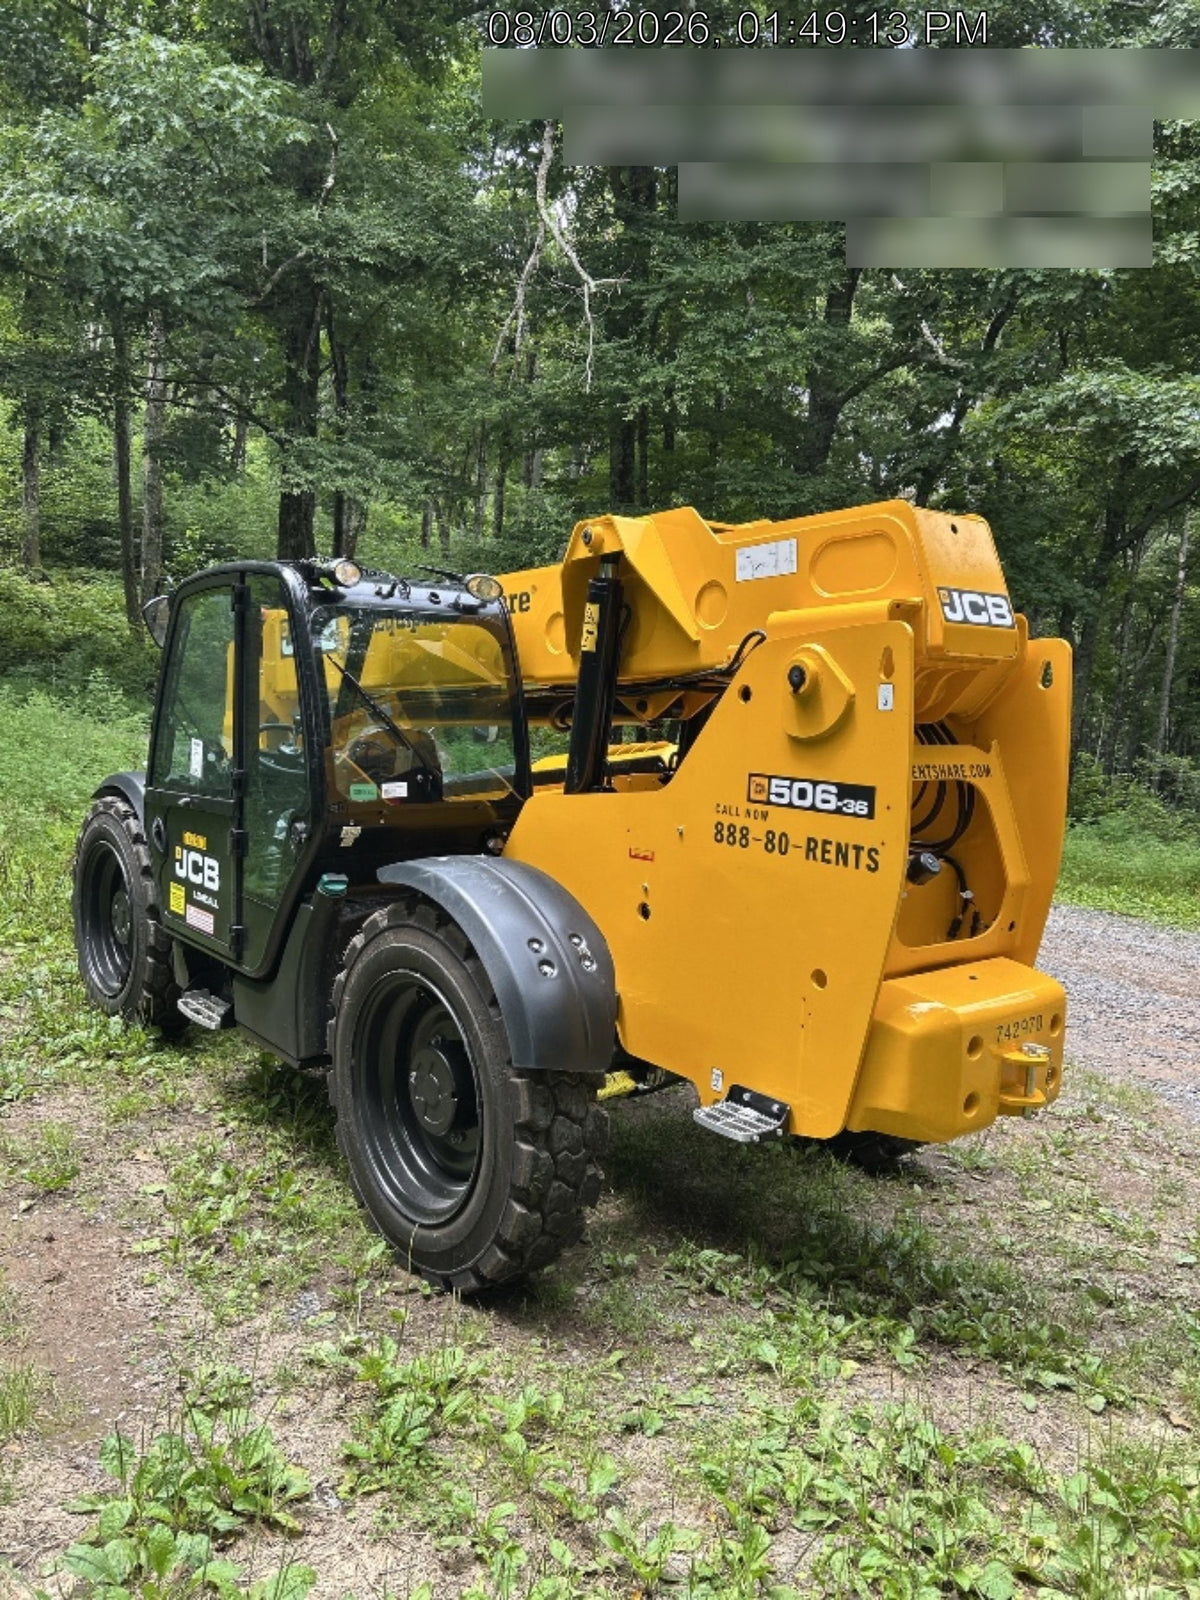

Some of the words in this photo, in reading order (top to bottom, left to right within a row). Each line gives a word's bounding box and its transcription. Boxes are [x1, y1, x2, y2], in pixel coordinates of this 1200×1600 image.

[504, 592, 531, 614] re
[942, 590, 1013, 627] JCB
[715, 803, 740, 817] CALL
[744, 807, 769, 822] NOW
[768, 777, 869, 816] 506-36
[713, 821, 880, 874] 888-80-RENTS
[174, 847, 220, 892] JCB
